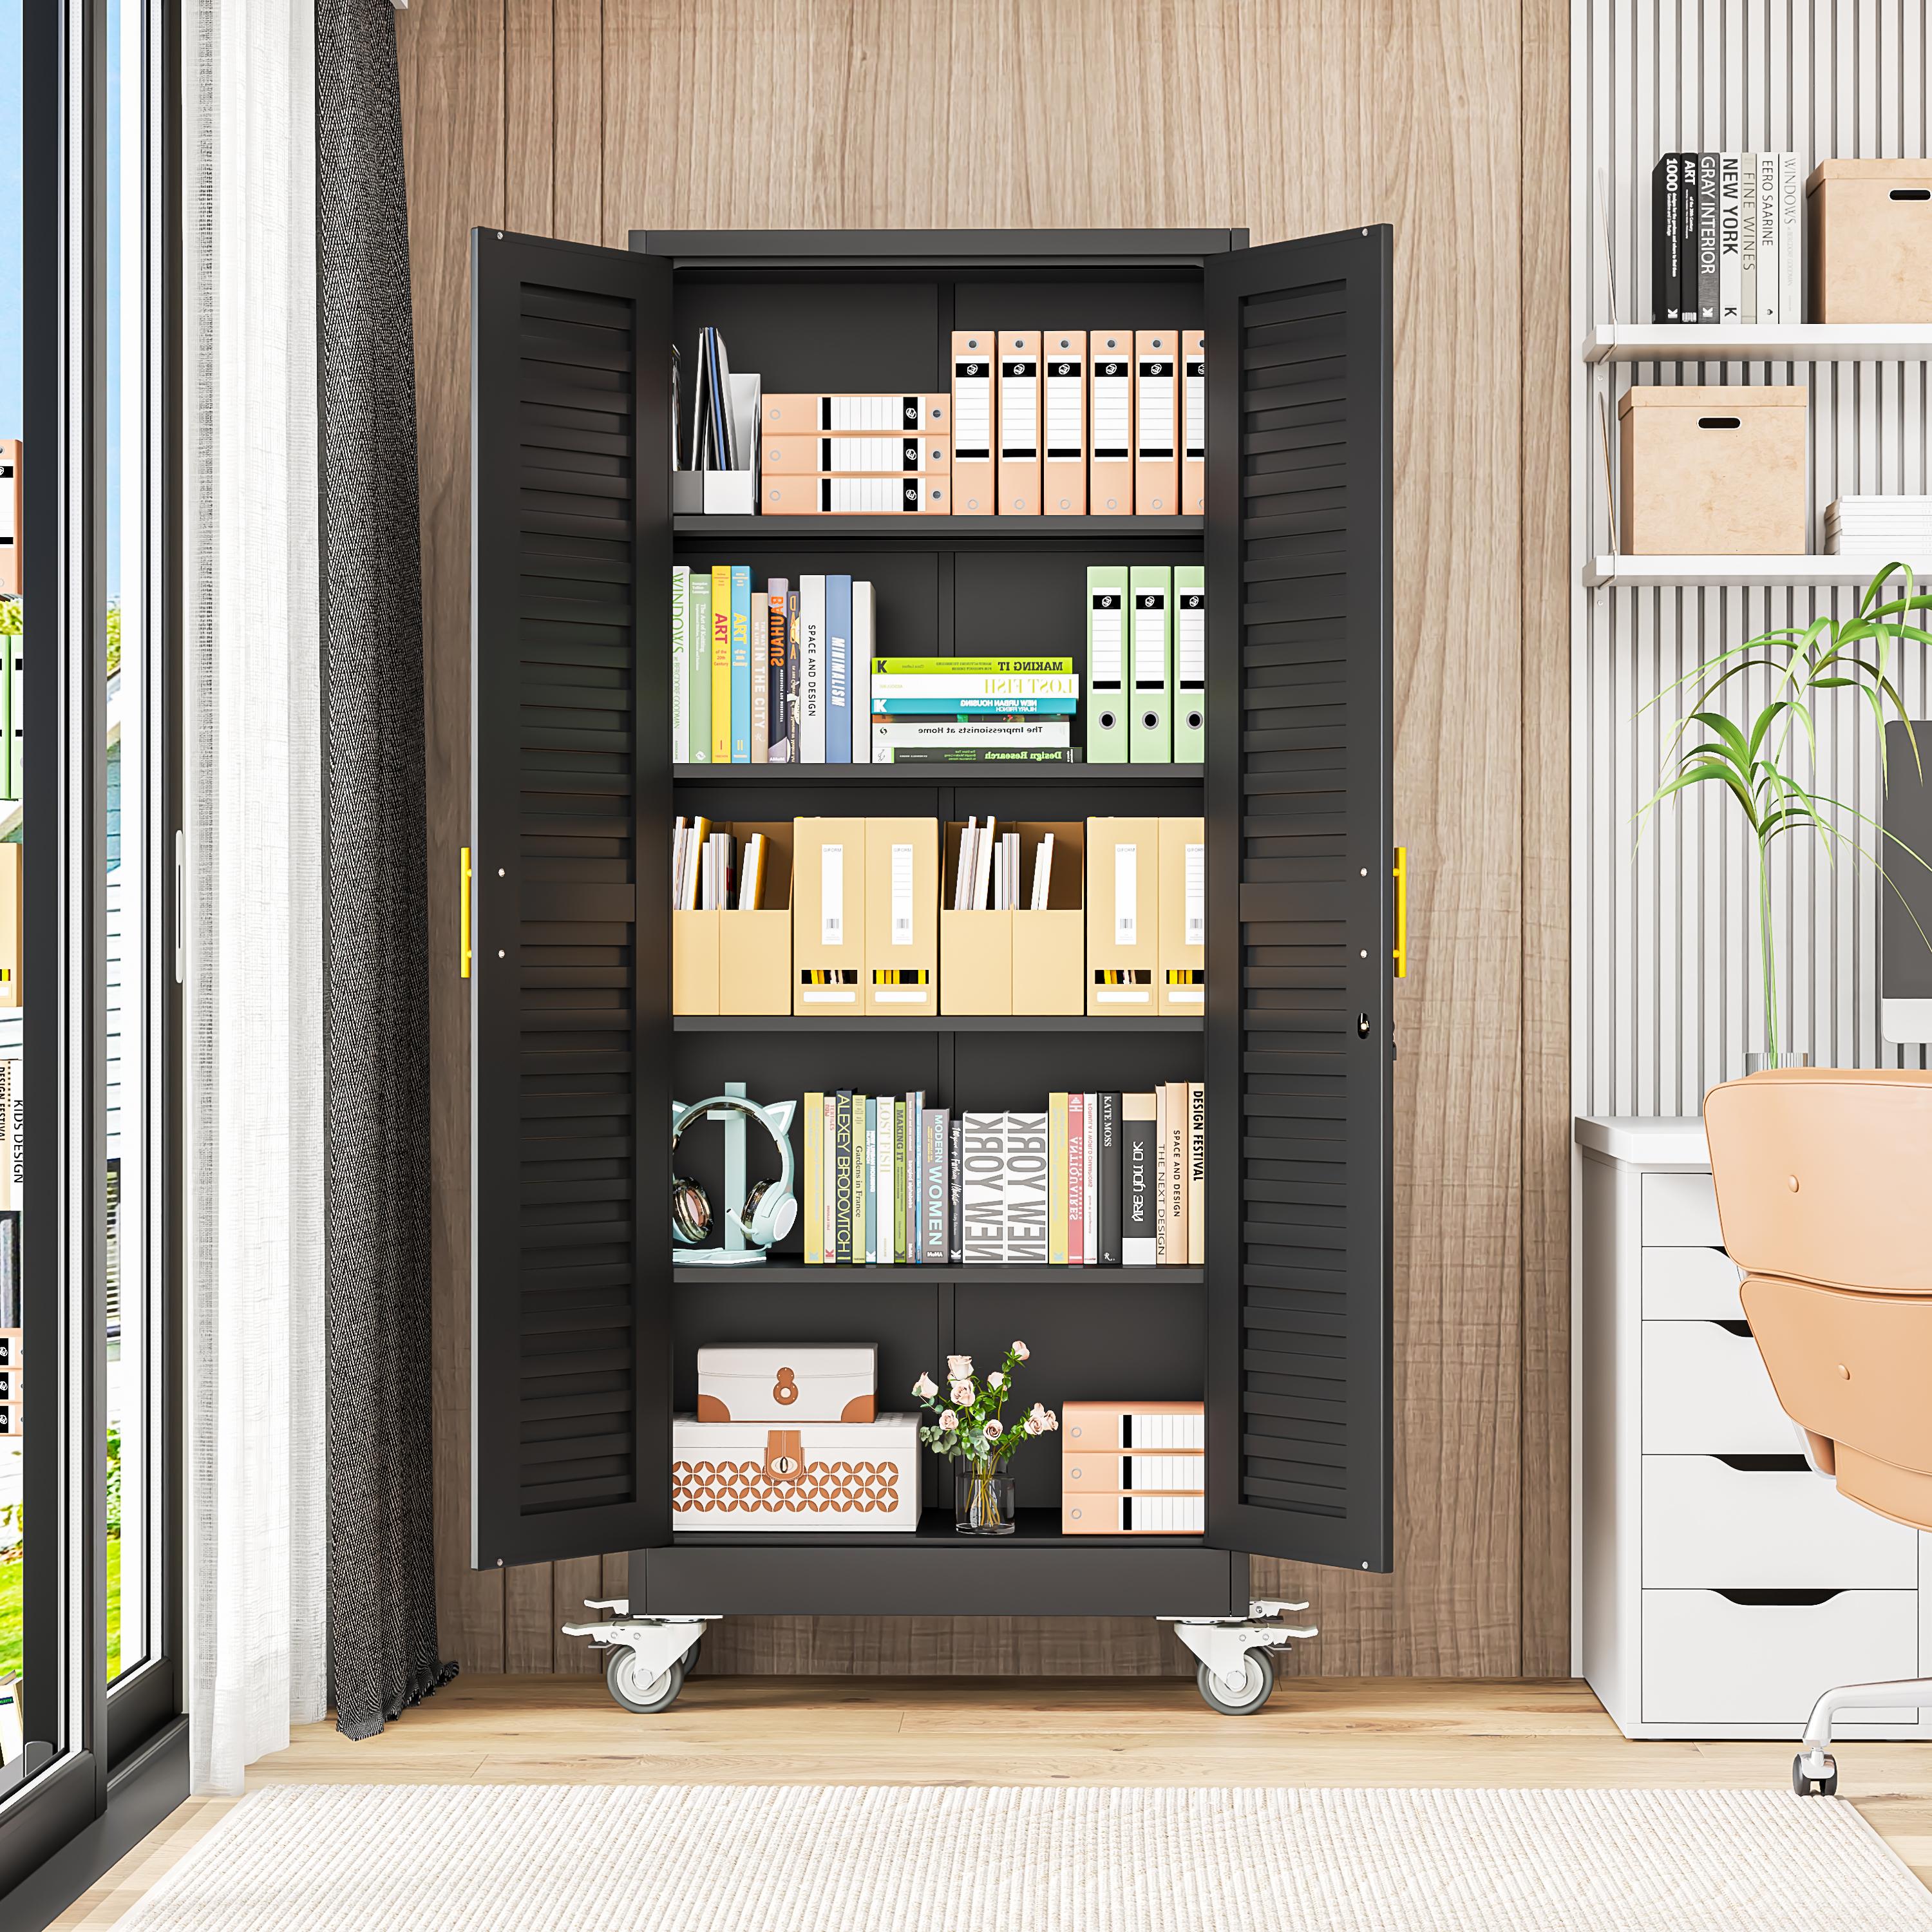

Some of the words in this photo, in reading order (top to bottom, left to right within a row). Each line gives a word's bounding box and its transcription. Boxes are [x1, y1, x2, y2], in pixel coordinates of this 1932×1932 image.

[1667, 158, 1677, 191] 1000
[1685, 161, 1695, 185] ART
[1701, 156, 1714, 198] GRAY
[1723, 158, 1738, 198] NEW
[1744, 173, 1754, 208] FINE
[1762, 161, 1773, 191] EERO
[1784, 158, 1796, 224] WINDOWS
[1701, 203, 1714, 273] INTERIOR
[1723, 206, 1738, 254] YORK
[1762, 195, 1773, 245] SAARINE
[1744, 217, 1754, 270] WINES
[672, 573, 683, 653] WINDOWS
[715, 613, 728, 644] ART
[734, 613, 747, 644] ART
[755, 647, 765, 661] IN
[831, 637, 845, 707] MINIMALISM
[755, 667, 765, 692] THE
[755, 698, 765, 728] CITY
[14, 1100, 23, 1130] KIDS
[838, 1095, 850, 1153] ALEXEY
[880, 1102, 891, 1137] LOST
[1193, 1091, 1203, 1130] DESIGN
[896, 1152, 904, 1162] IT
[934, 1115, 943, 1162] MODERN
[1132, 1142, 1144, 1160] OK
[14, 1135, 23, 1182] DESIGN
[880, 1142, 891, 1173] FISH
[951, 1159, 960, 1179] Fashion
[1193, 1135, 1203, 1180] FESTIVAL
[838, 1157, 850, 1252] BRODOVITCH
[929, 1166, 942, 1245] WOMEN
[1132, 1195, 1144, 1221] ARE
